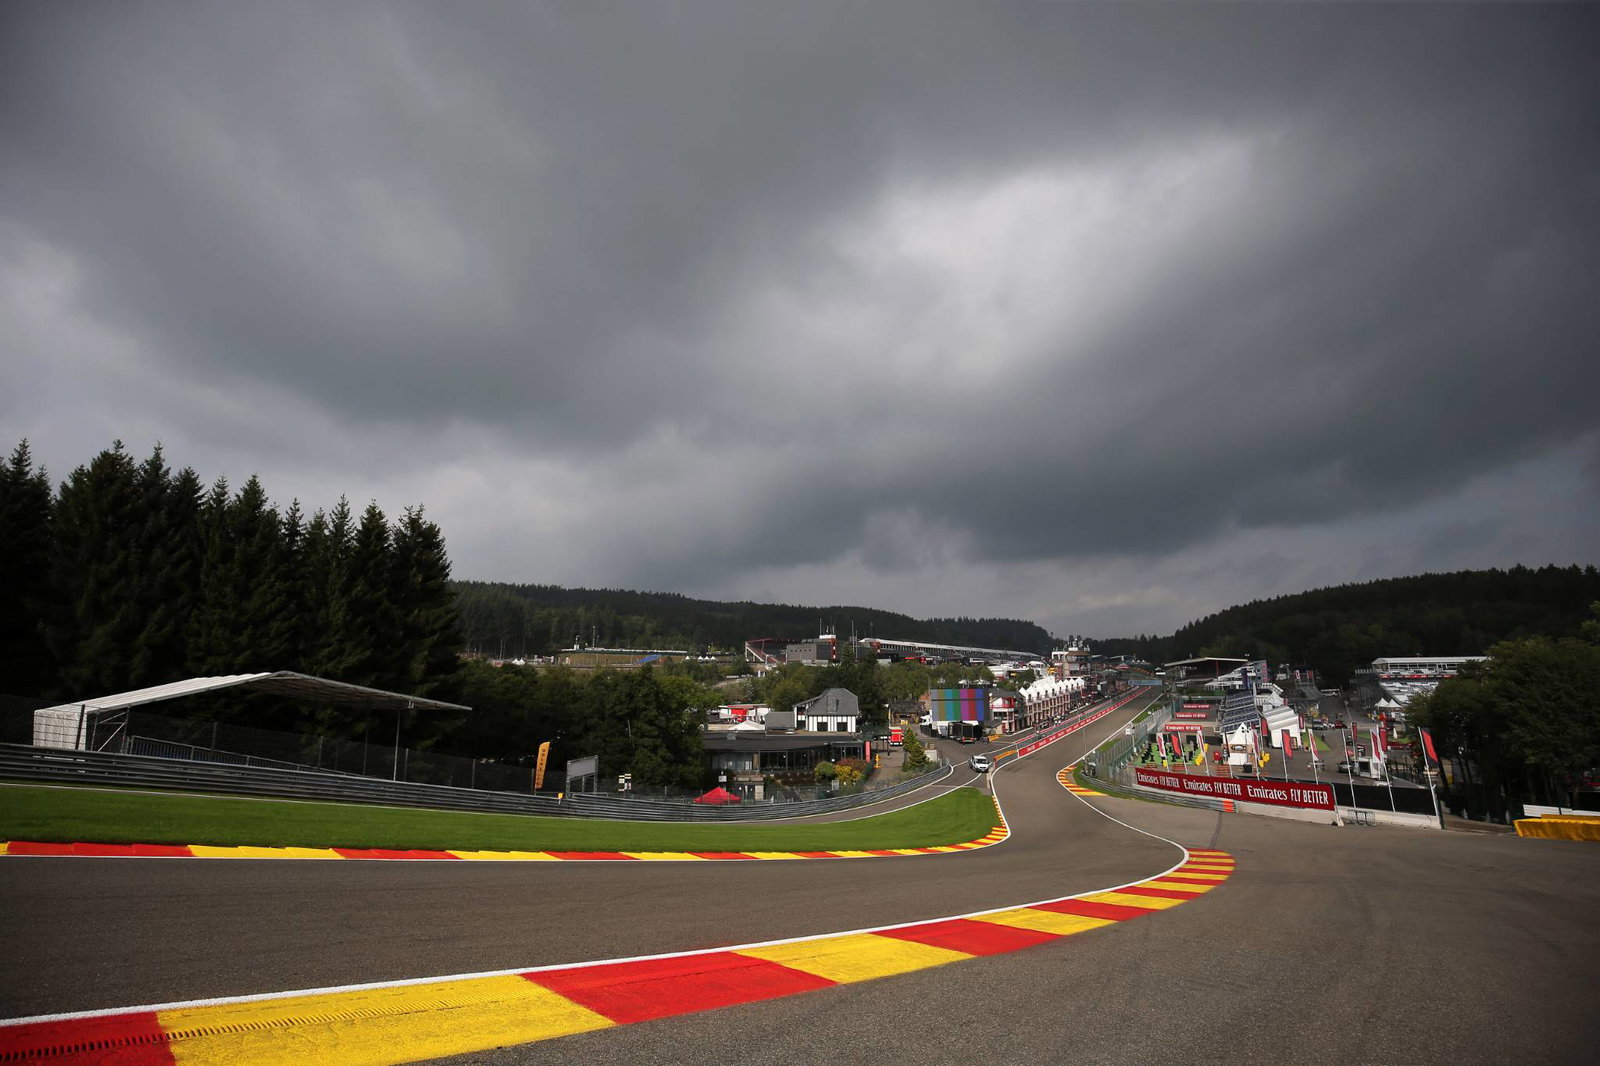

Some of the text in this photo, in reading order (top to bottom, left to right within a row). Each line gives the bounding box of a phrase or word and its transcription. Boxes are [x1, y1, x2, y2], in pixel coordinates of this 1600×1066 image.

[1137, 772, 1159, 784] Emirates
[1183, 779, 1242, 796] Emirates FLY BETTER
[1247, 785, 1329, 804] Emirates FLY BETTER
